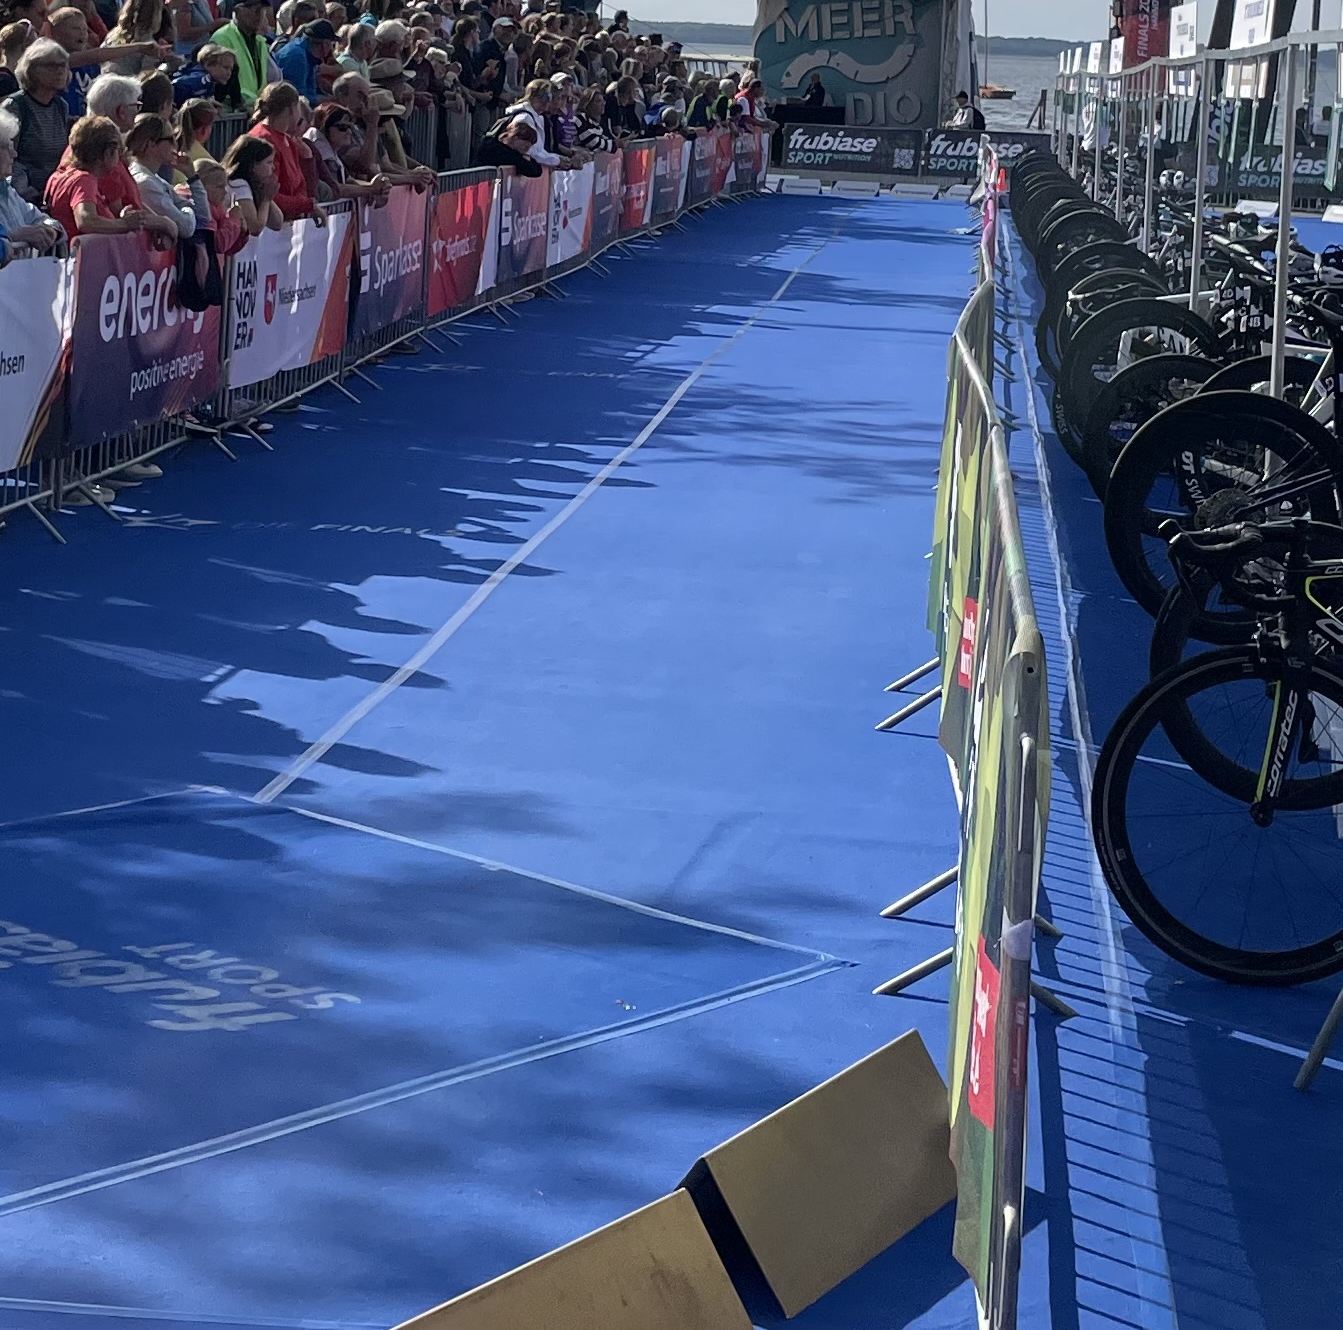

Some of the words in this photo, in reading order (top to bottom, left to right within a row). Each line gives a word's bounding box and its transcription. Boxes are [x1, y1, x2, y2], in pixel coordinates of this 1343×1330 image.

[1137, 13, 1150, 58] FINALS
[788, 127, 878, 154] frubiase
[929, 133, 1023, 158] frubse
[787, 152, 833, 166] SPORT
[1237, 175, 1281, 189] SPOR
[373, 235, 424, 298] Sparkasse
[130, 357, 169, 401] positive
[168, 344, 205, 386] energie
[1181, 450, 1195, 475] DT
[1266, 689, 1299, 798] corratec
[121, 941, 363, 1010] SPORT
